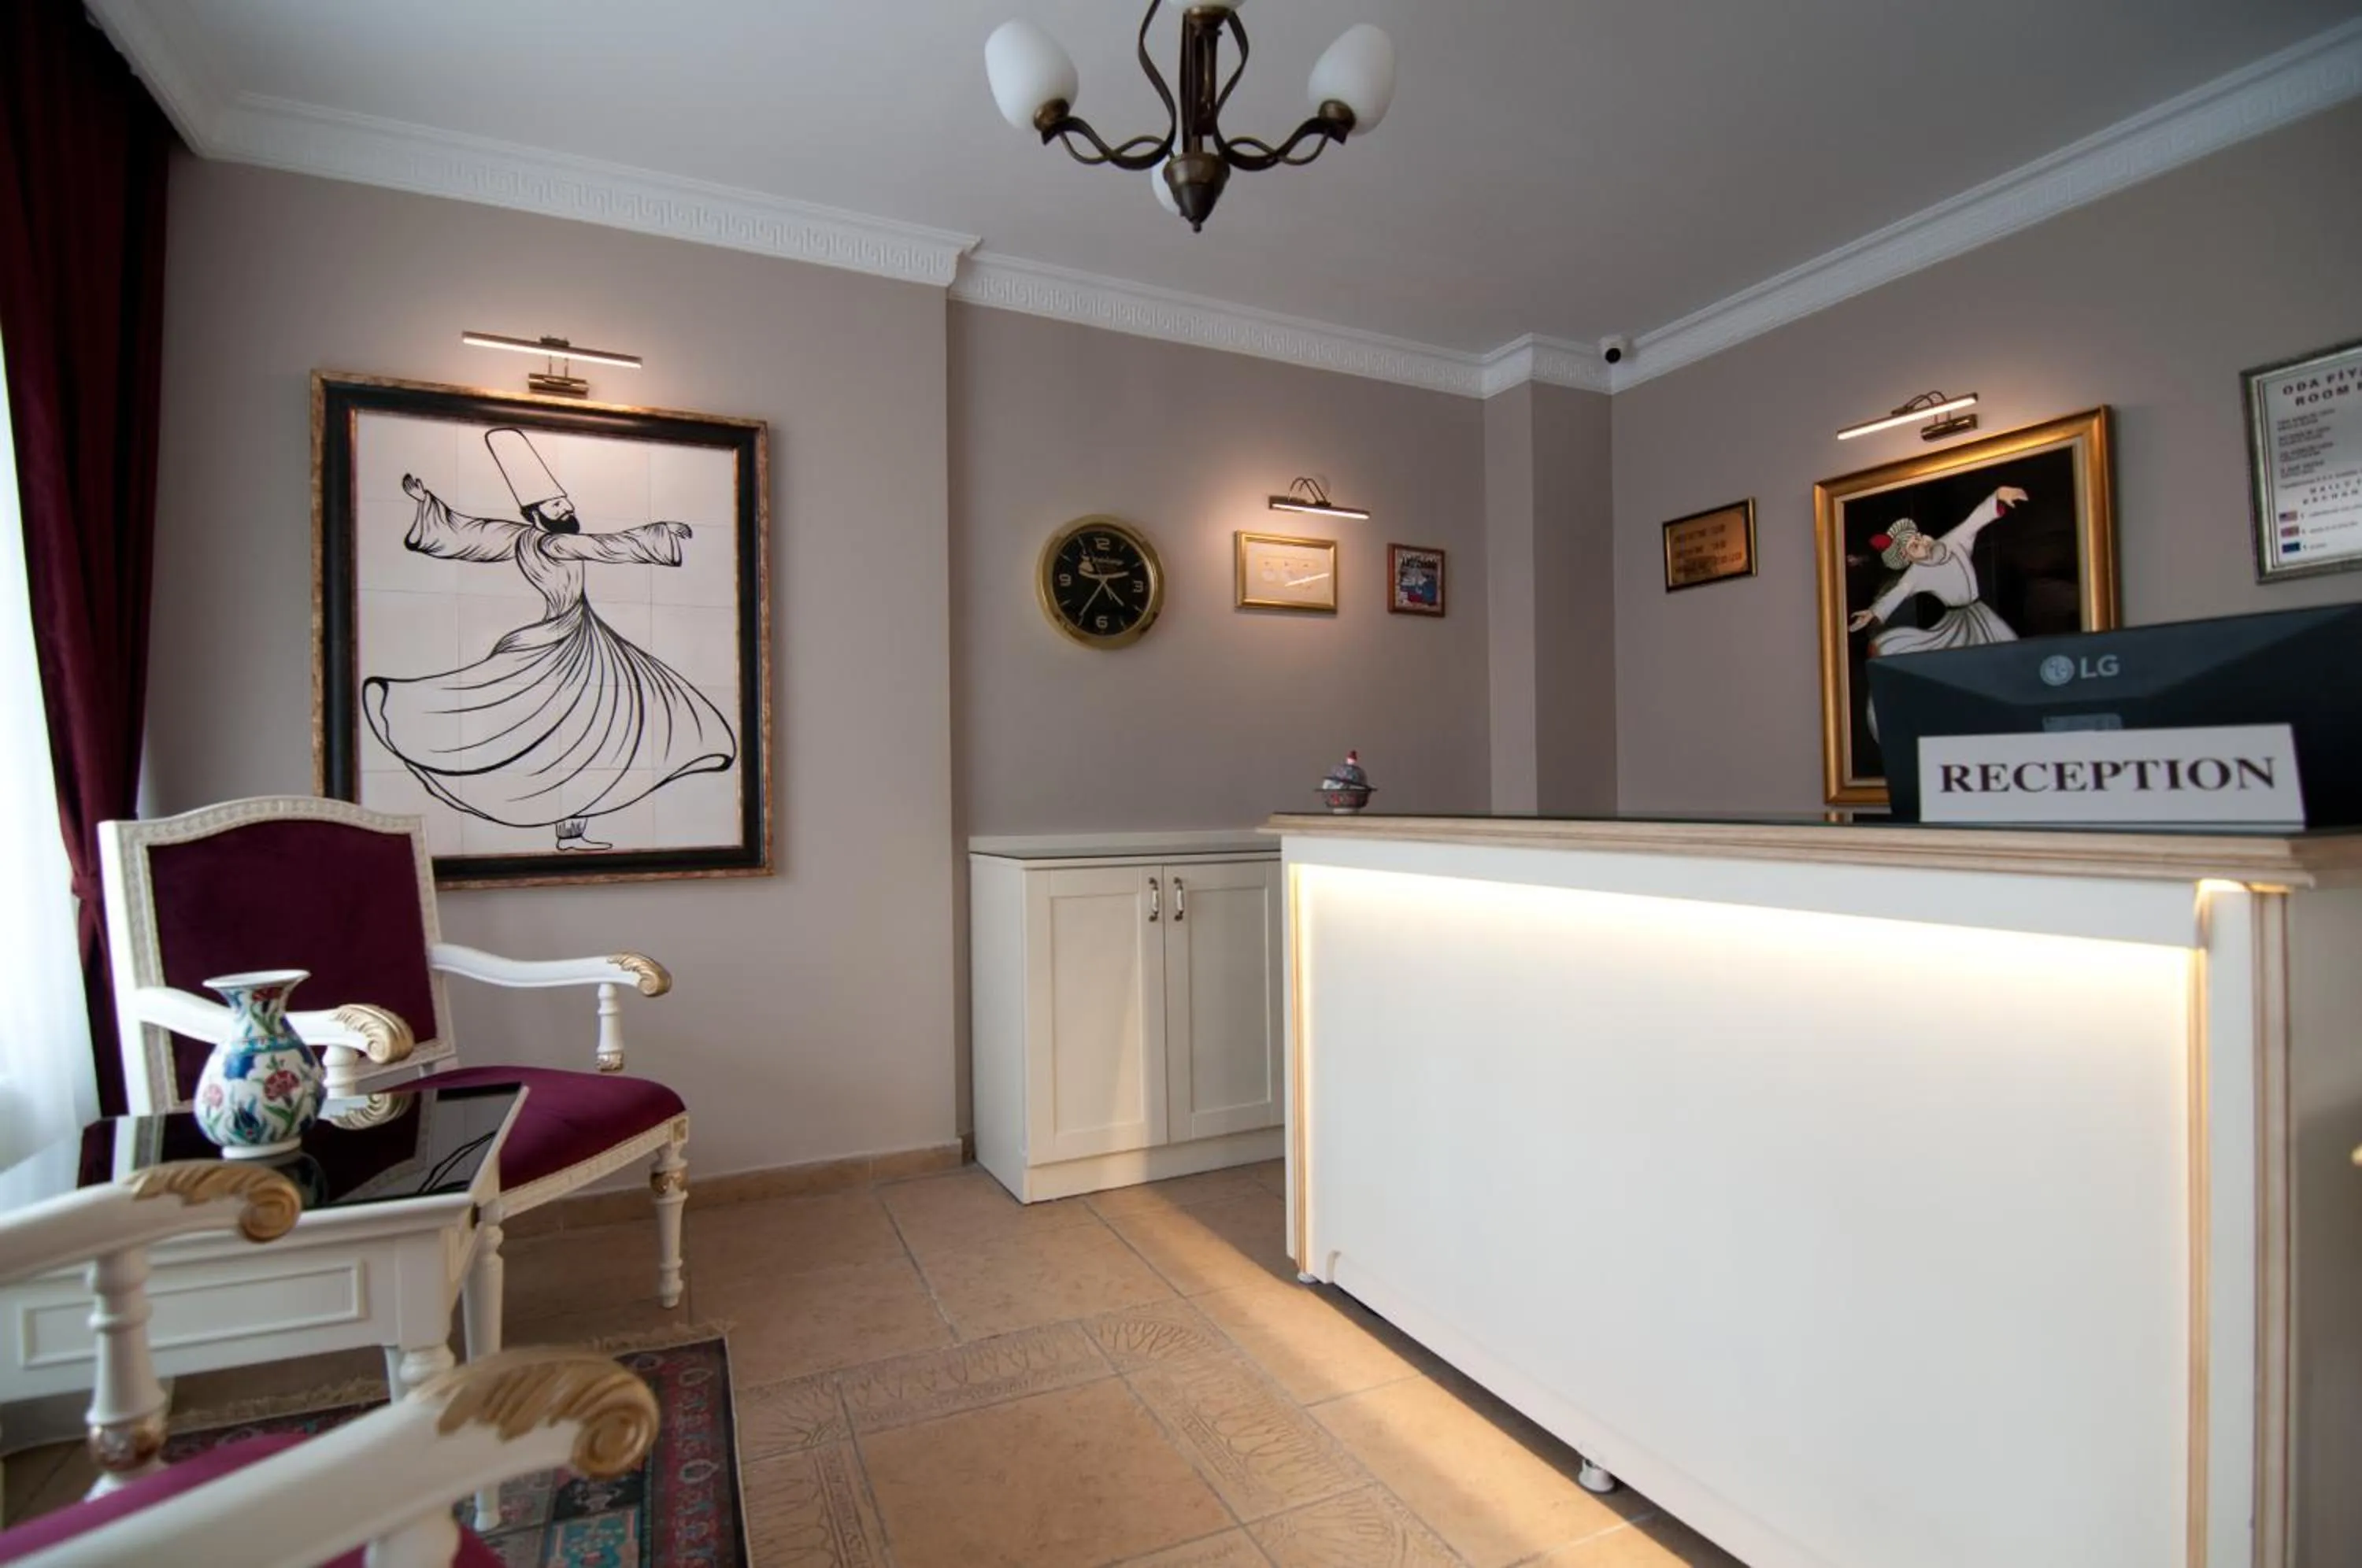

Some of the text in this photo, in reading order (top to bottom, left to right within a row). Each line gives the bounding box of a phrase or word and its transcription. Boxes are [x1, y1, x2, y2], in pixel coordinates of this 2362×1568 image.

[2282, 379, 2319, 395] ODA
[2295, 384, 2349, 406] ROOM
[1059, 574, 1072, 586] 9
[1133, 580, 1144, 593] 3
[1095, 616, 1108, 629] 6
[2080, 655, 2120, 679] LG
[1939, 756, 2275, 793] RECEPTION
